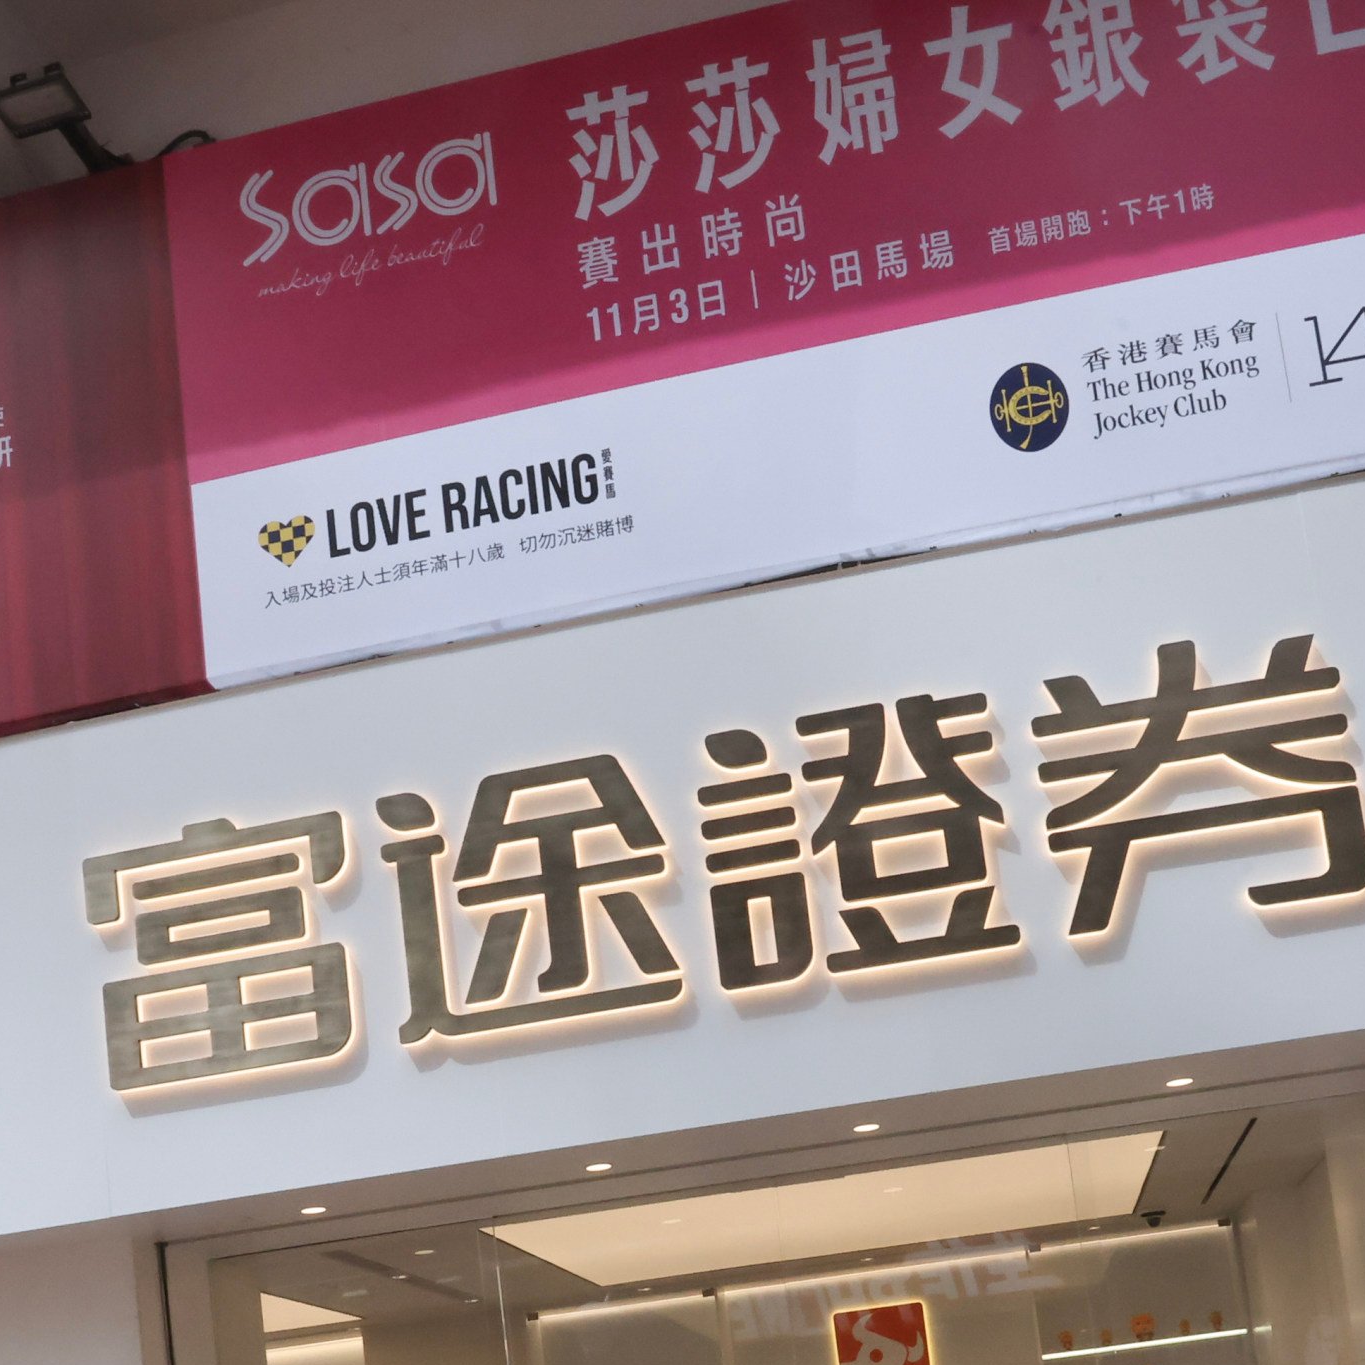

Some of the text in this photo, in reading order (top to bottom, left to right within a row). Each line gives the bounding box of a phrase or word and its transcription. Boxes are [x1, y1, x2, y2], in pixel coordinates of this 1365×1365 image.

[257, 223, 484, 298] making life beautiful
[575, 193, 807, 289] 賽出時尚
[585, 280, 728, 342] 11月3日
[783, 228, 954, 302] 沙田馬場
[1081, 317, 1258, 374] 香港賽馬會
[1086, 351, 1261, 403] The Hong Kong
[1092, 388, 1228, 440] Jockey Club
[325, 453, 599, 559] LOVE RACING
[600, 447, 617, 500] 愛賽馬
[263, 513, 636, 610] 入場及投注人士須年滿十八歲 切勿沉迷賭博
